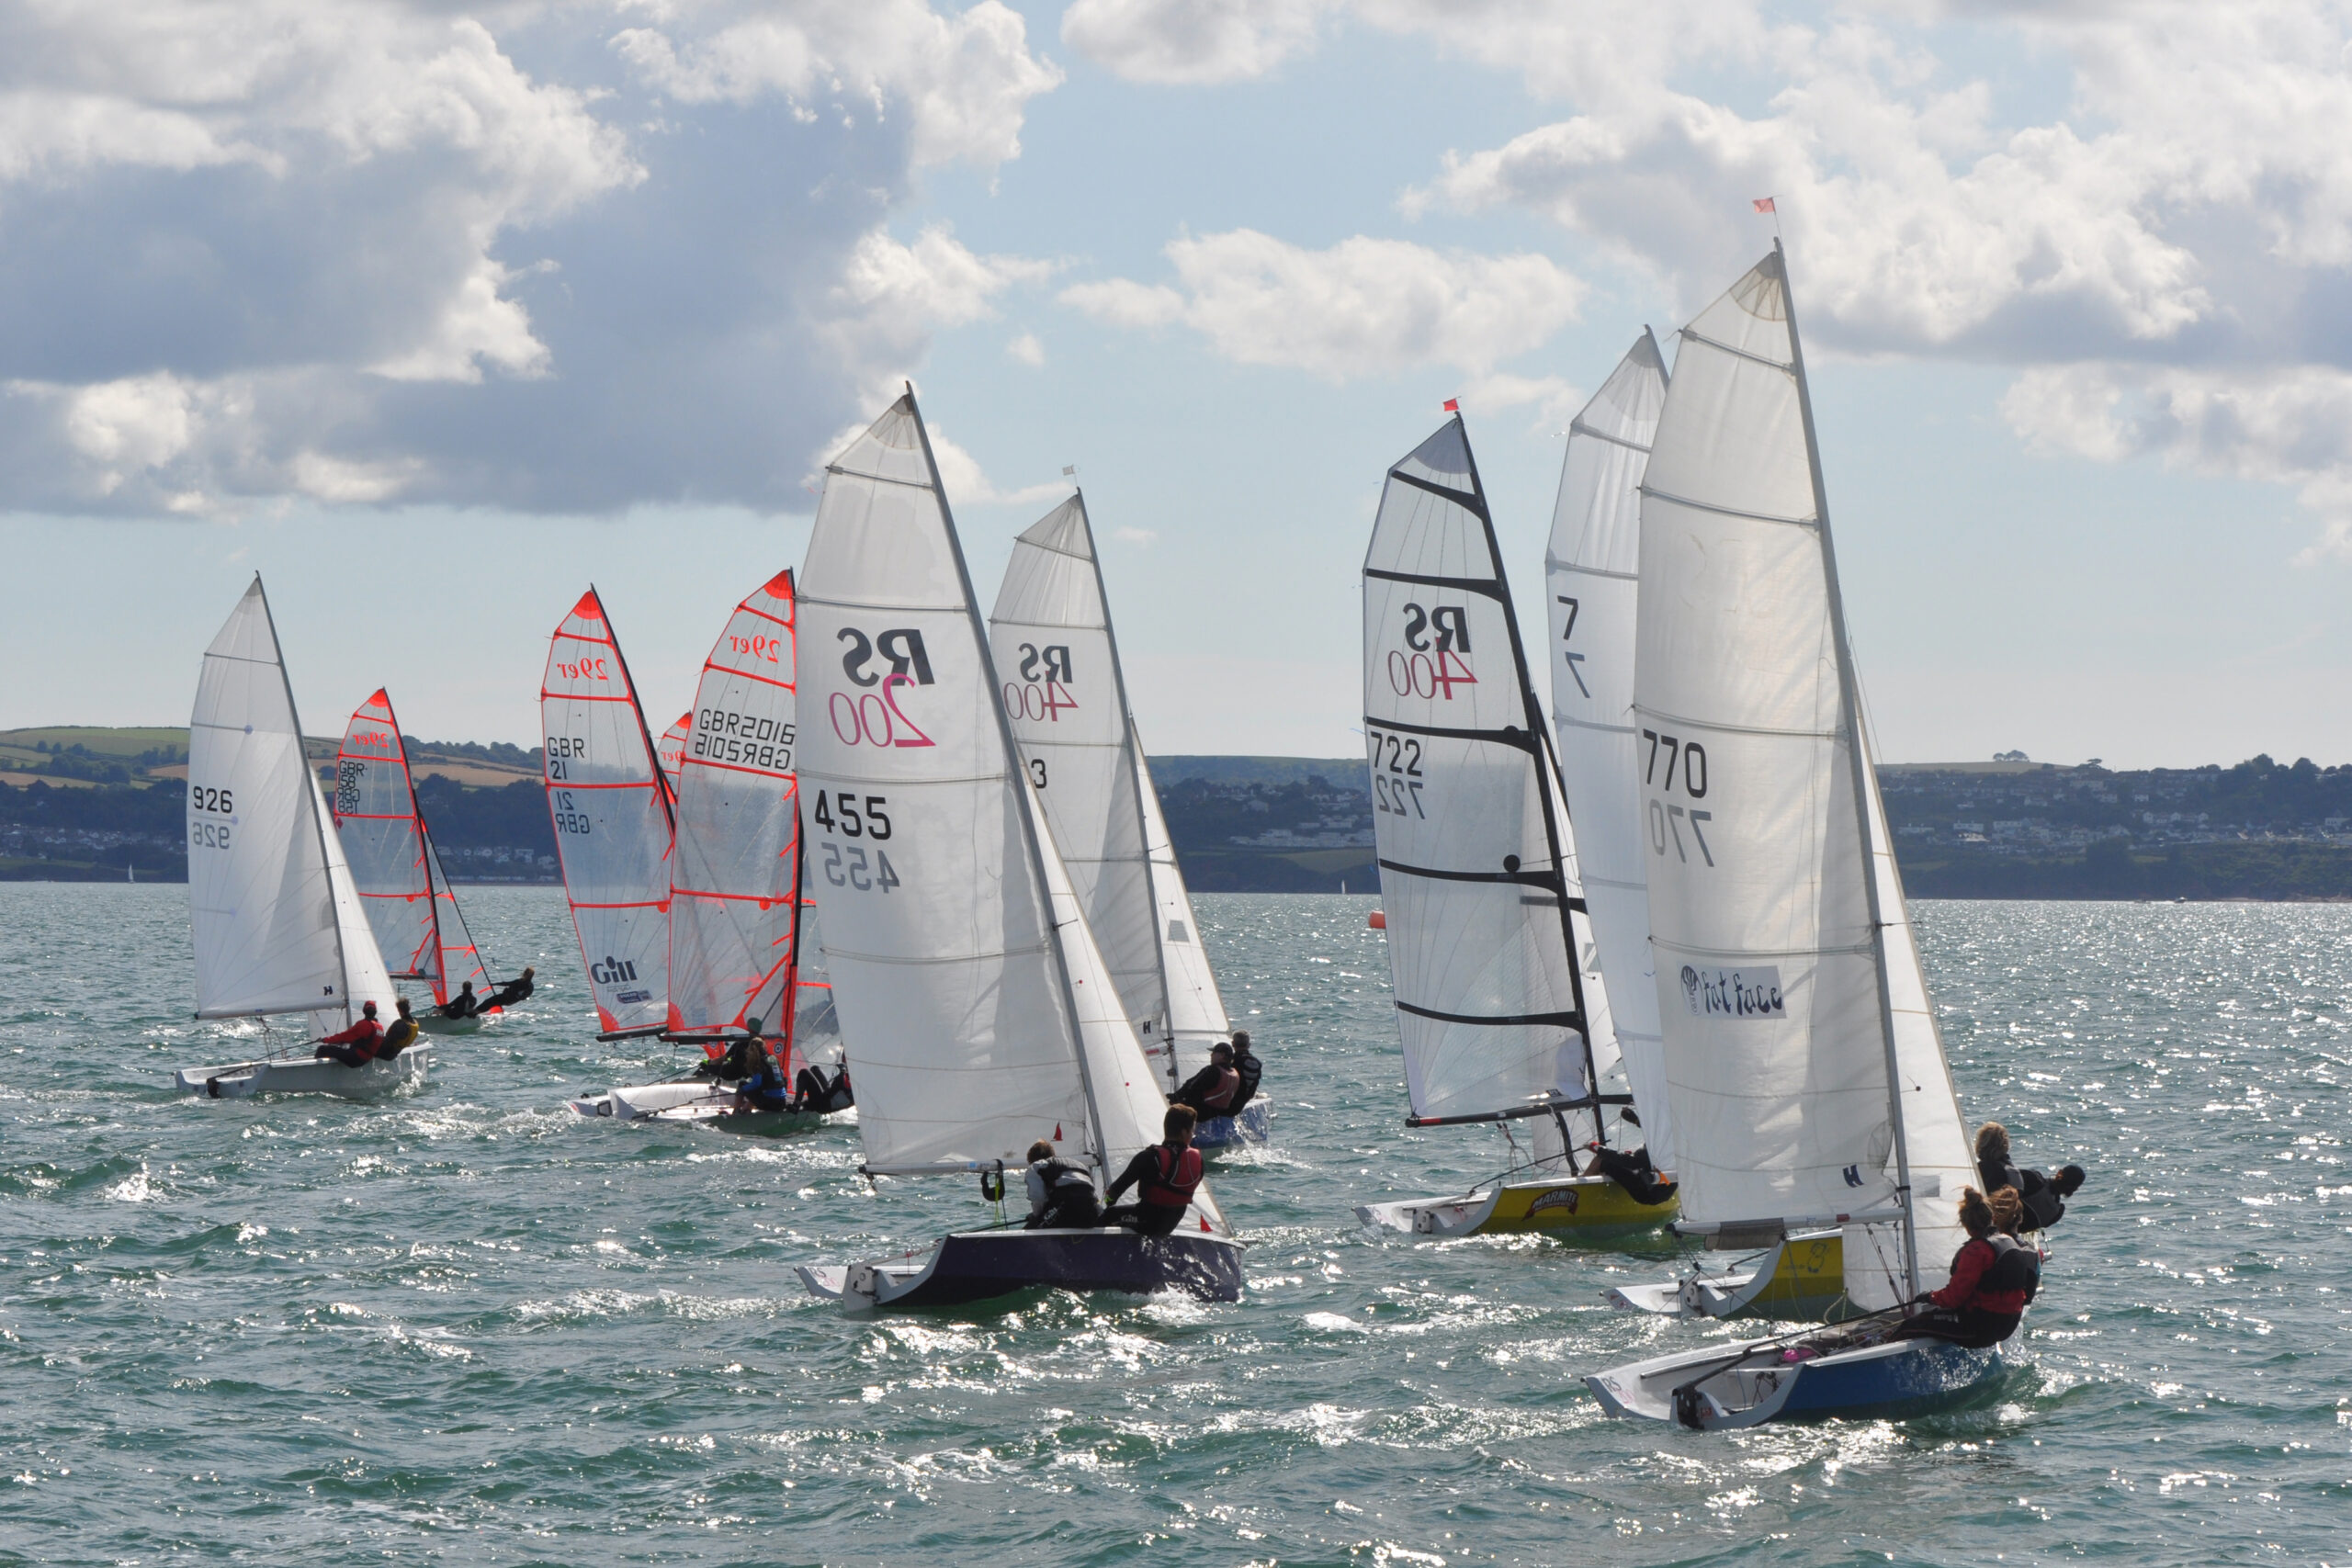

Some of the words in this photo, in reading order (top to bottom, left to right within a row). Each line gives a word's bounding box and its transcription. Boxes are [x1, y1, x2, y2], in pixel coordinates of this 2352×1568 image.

[1557, 595, 1578, 640] 7
[548, 737, 585, 759] GBR
[1371, 732, 1422, 777] 722
[339, 761, 365, 776] GBR
[550, 760, 567, 780] 21
[1643, 728, 1707, 799] 770
[193, 785, 233, 814] 926
[815, 789, 891, 840] 455
[591, 956, 638, 985] Gill
[1532, 1189, 1577, 1210] MARMITE
